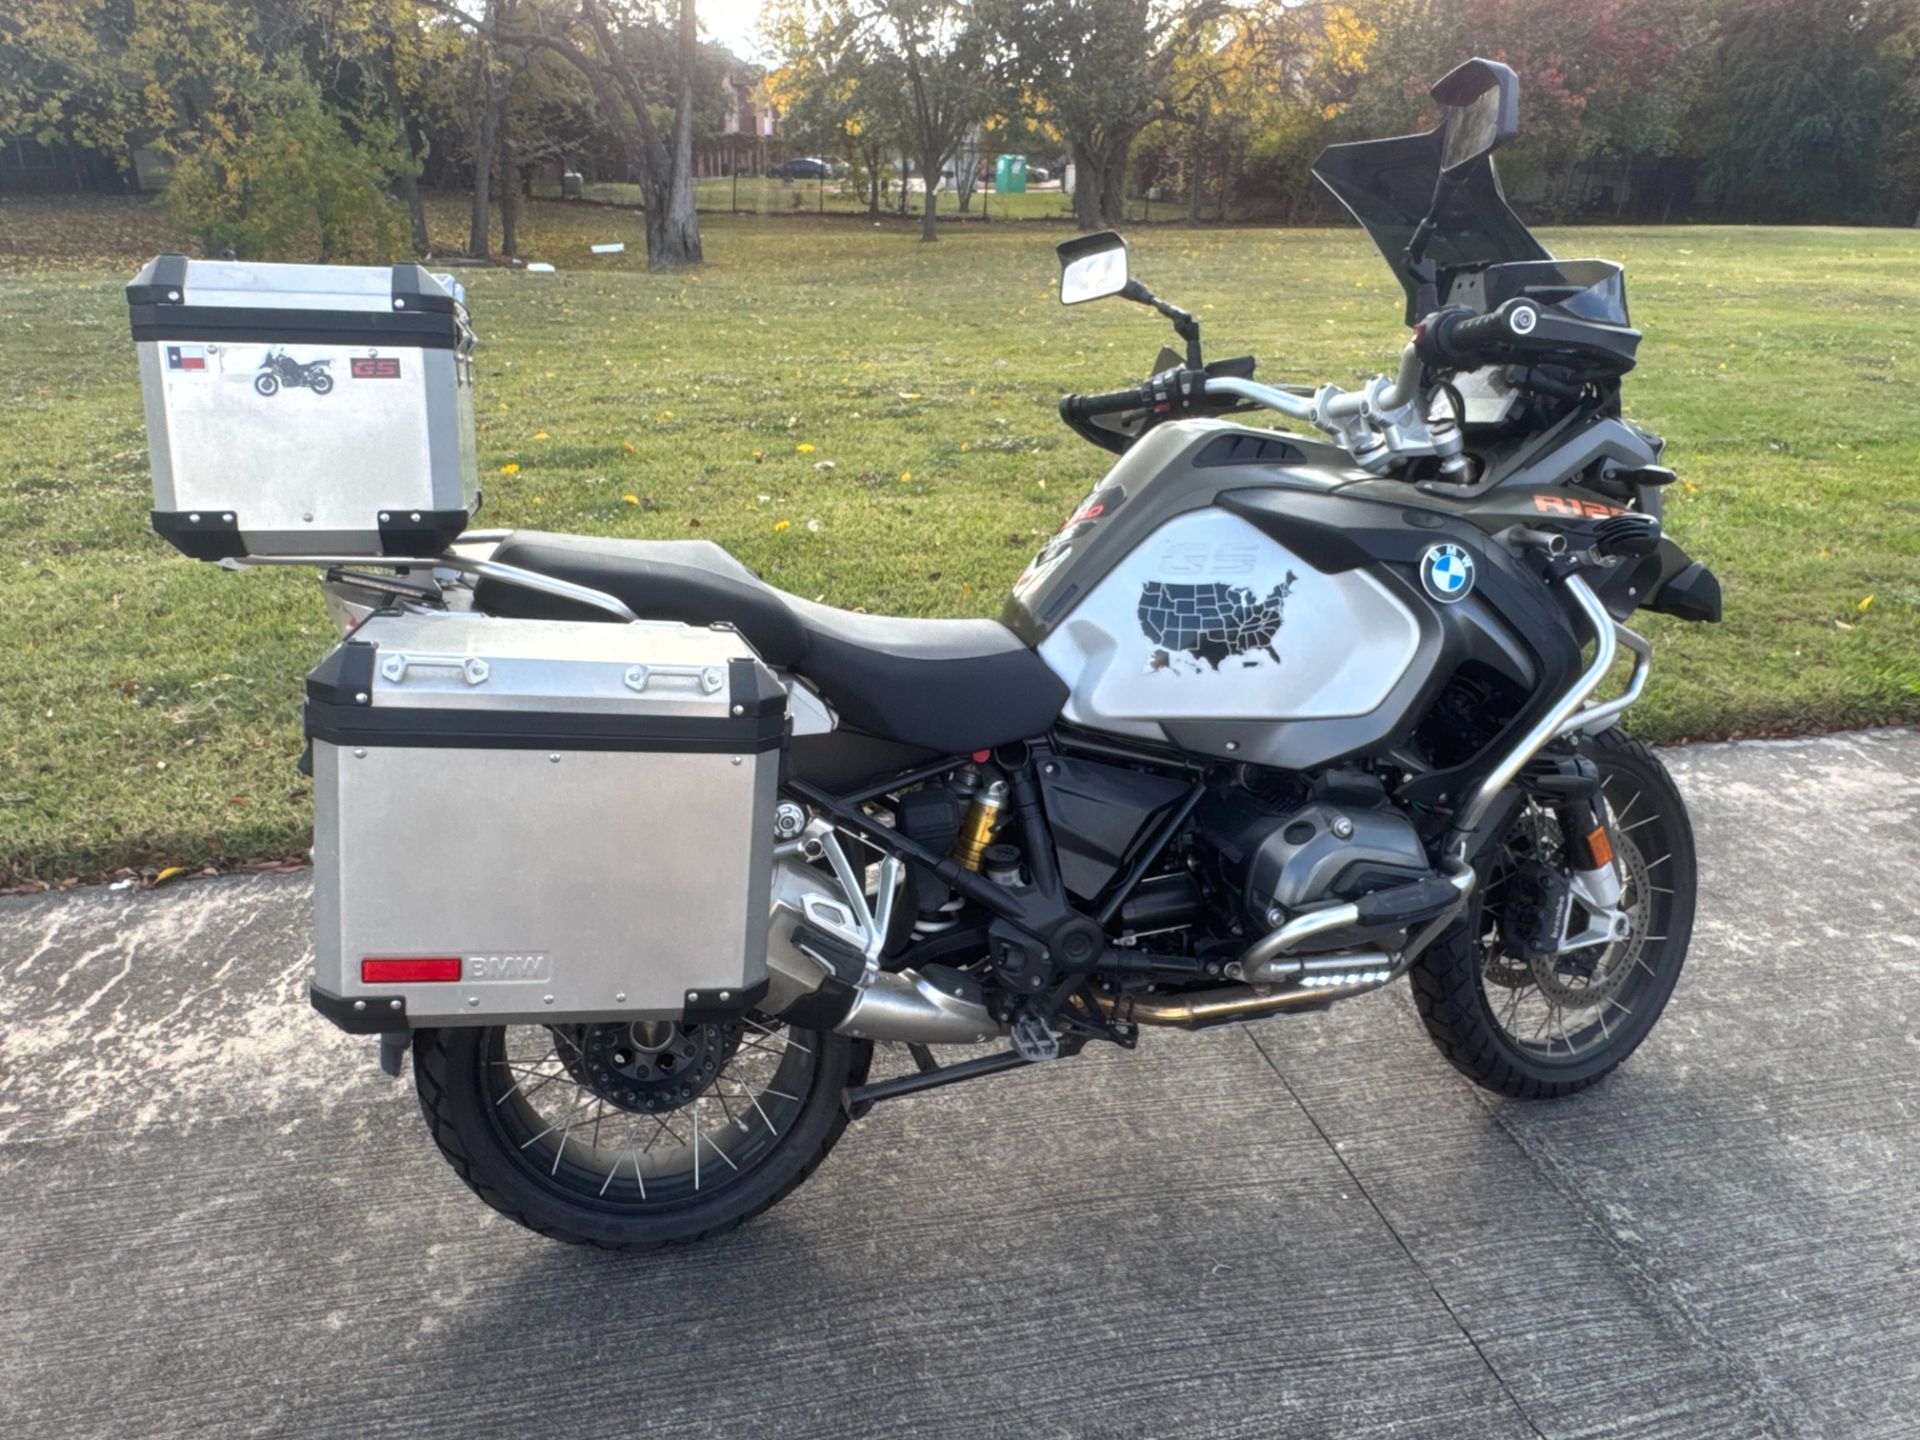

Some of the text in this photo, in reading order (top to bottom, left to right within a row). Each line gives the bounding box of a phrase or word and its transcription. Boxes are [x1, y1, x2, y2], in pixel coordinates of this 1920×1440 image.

[353, 361, 397, 376] GS
[1158, 542, 1260, 576] GS
[1428, 544, 1473, 568] BMW
[1550, 895, 1565, 939] brembo
[468, 956, 544, 977] BMW
